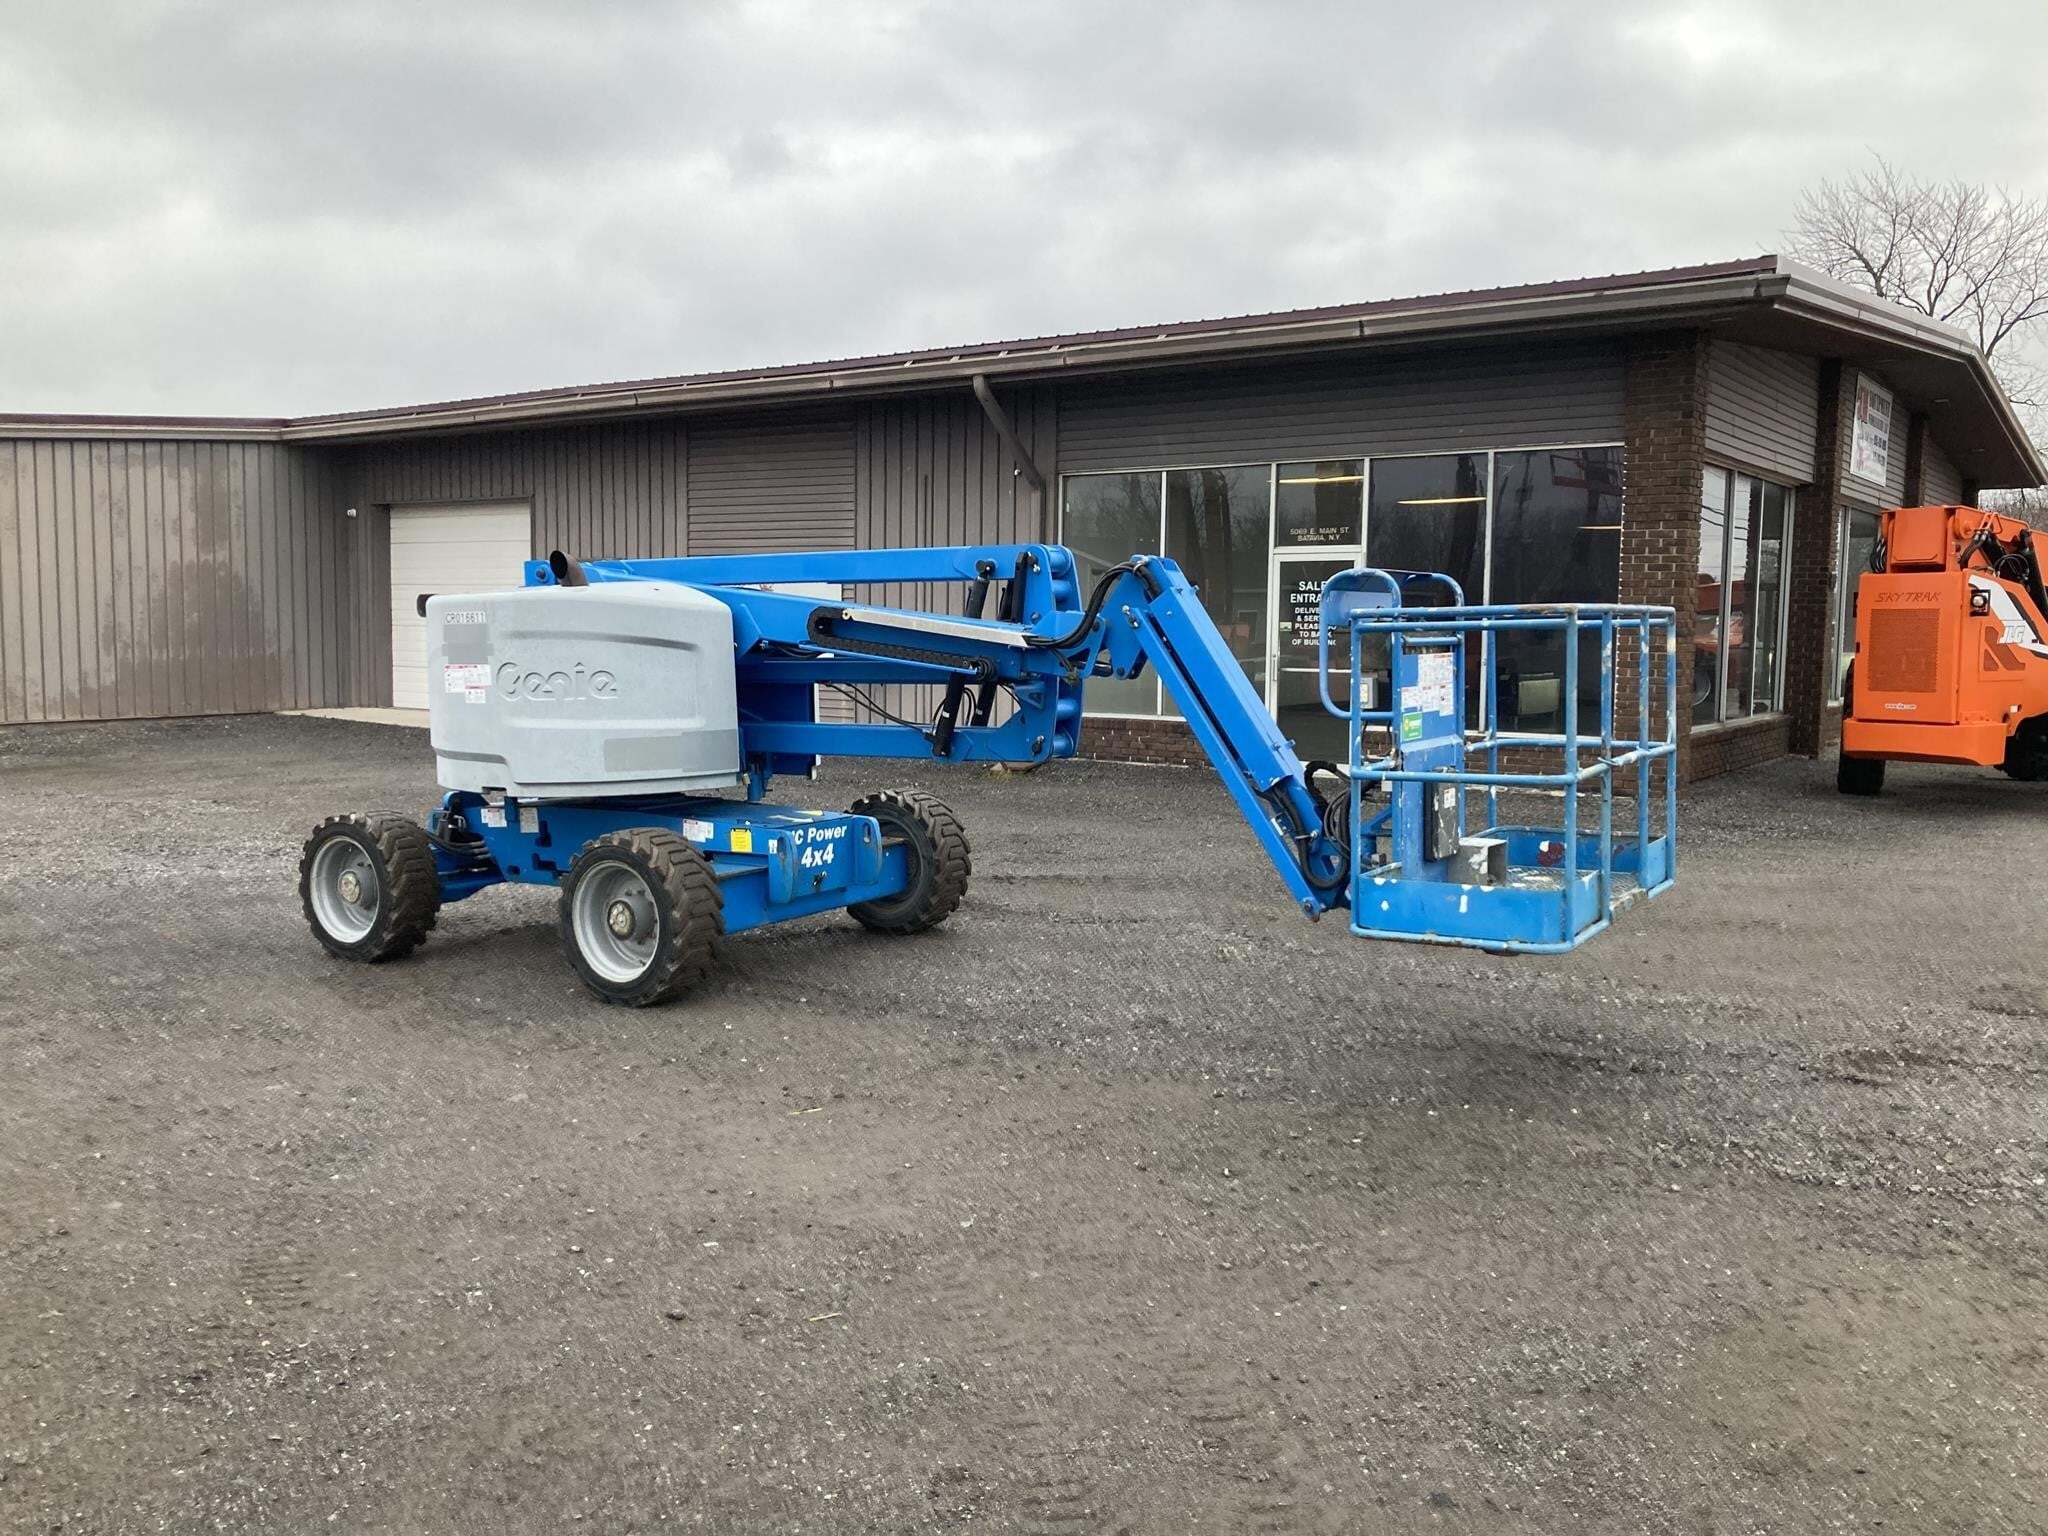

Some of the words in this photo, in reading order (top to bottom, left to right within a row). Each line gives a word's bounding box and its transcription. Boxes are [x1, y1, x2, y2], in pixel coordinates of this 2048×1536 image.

[1299, 581, 1326, 591] SALE
[1290, 593, 1322, 603] ENTRA
[497, 661, 619, 701] Genie
[807, 824, 847, 843] Power
[801, 843, 834, 868] 4x4
